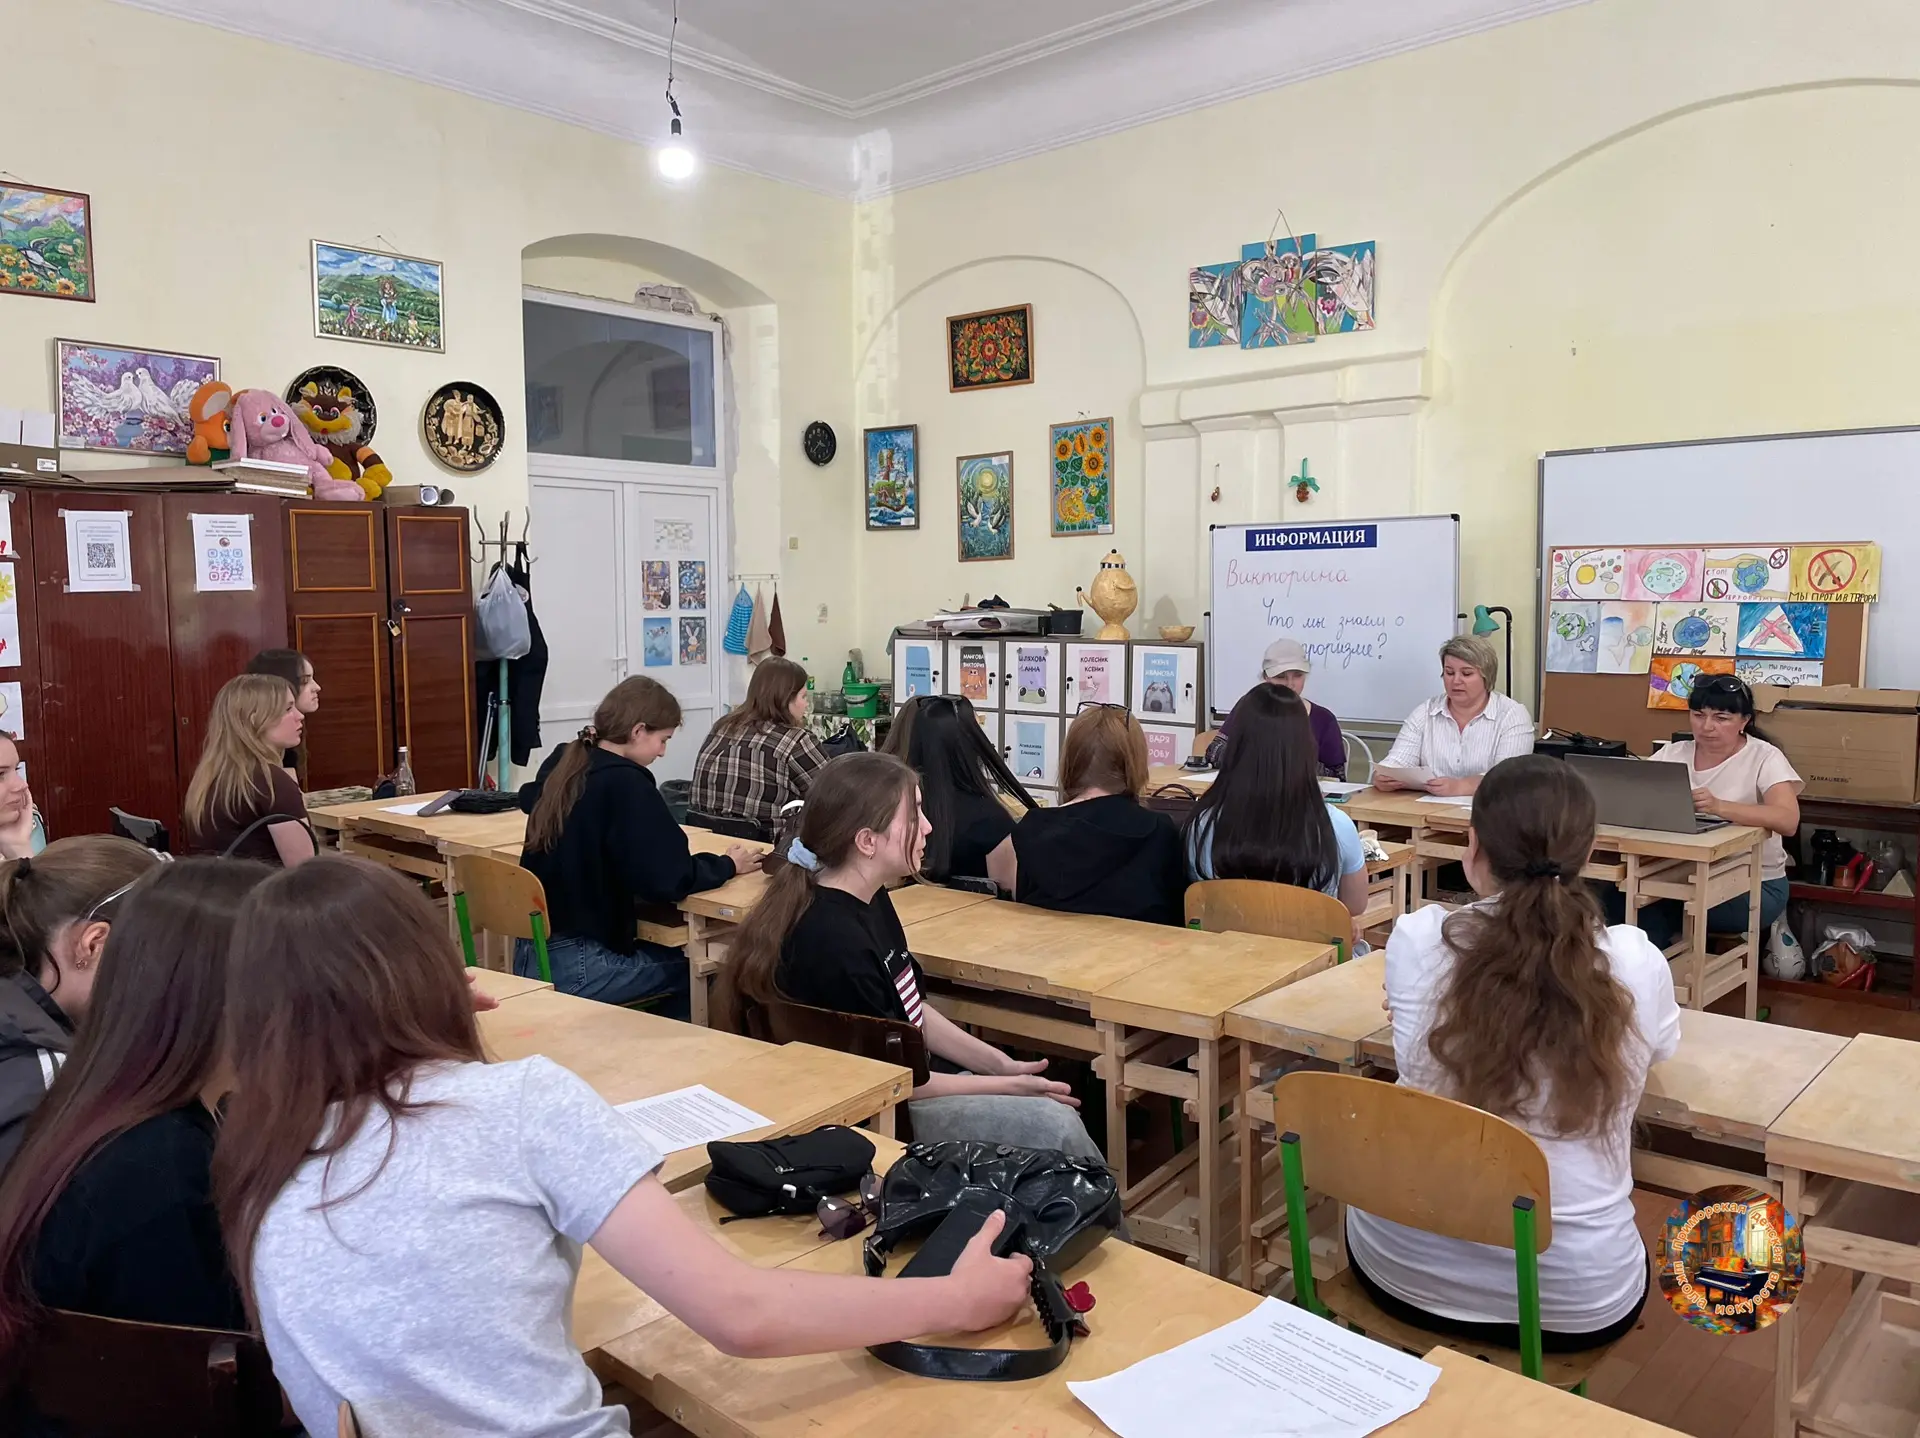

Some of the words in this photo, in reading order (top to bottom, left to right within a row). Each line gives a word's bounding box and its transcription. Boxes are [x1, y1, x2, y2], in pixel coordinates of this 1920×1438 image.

[1255, 530, 1365, 547] ИНФОРМАЦИЯ
[1226, 559, 1348, 597] Викторина
[1788, 592, 1808, 601] МЫ
[1263, 597, 1294, 629] Что
[1303, 617, 1325, 628] мы
[1394, 616, 1405, 627] о
